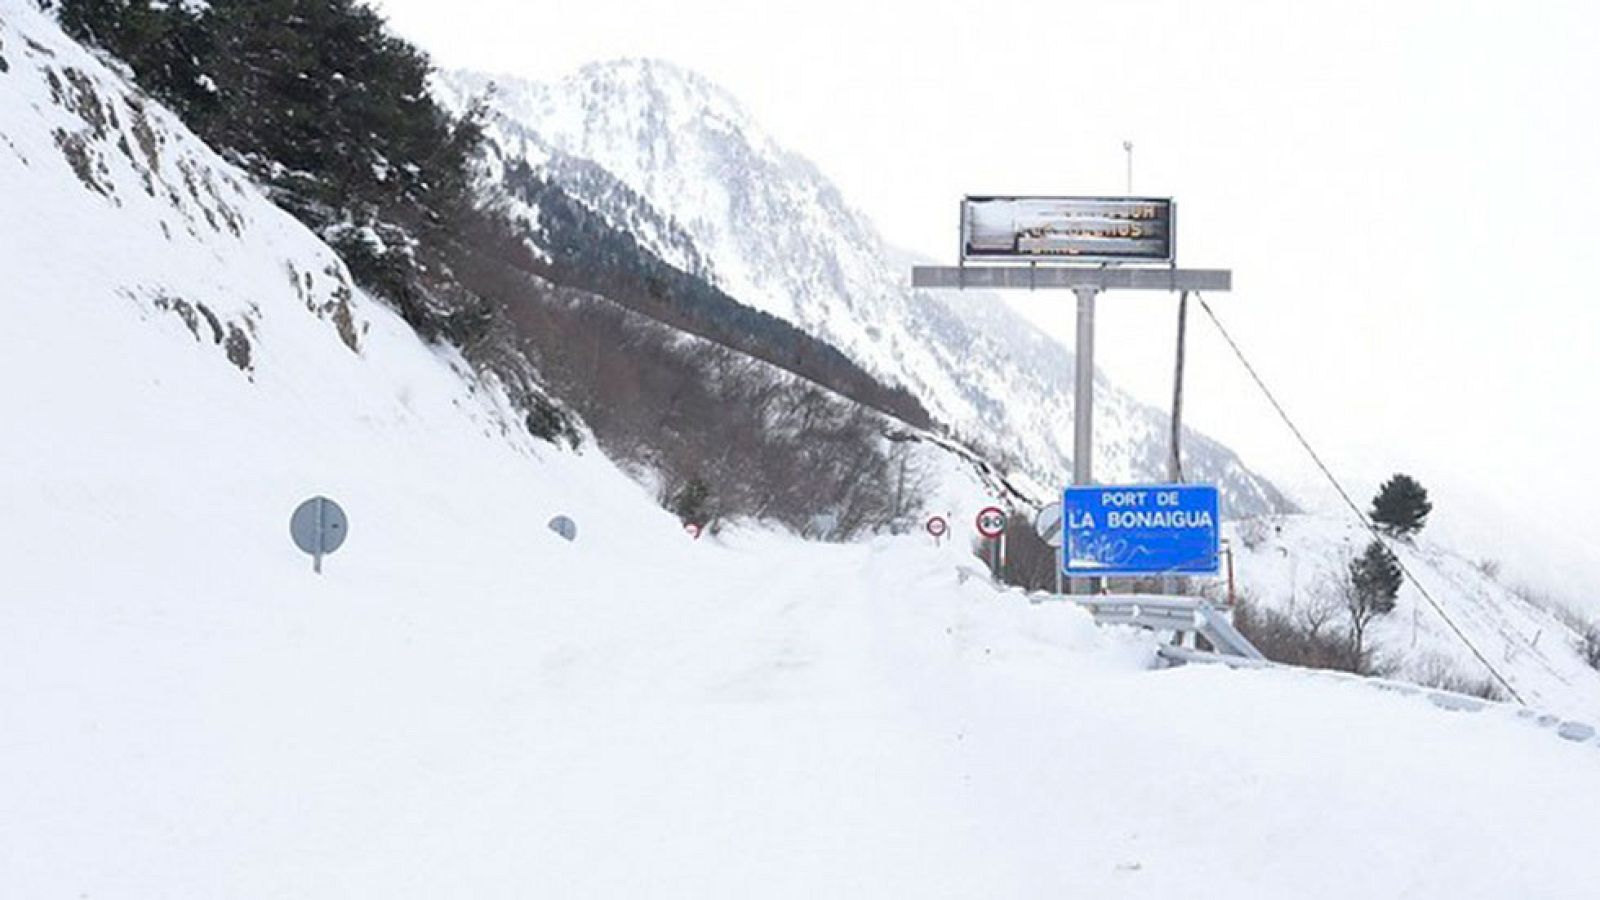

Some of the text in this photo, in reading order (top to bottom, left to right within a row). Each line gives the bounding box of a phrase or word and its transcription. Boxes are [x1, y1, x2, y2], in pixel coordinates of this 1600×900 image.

[1102, 492, 1179, 506] PORT DE
[1068, 511, 1214, 529] LA BONAIGUA
